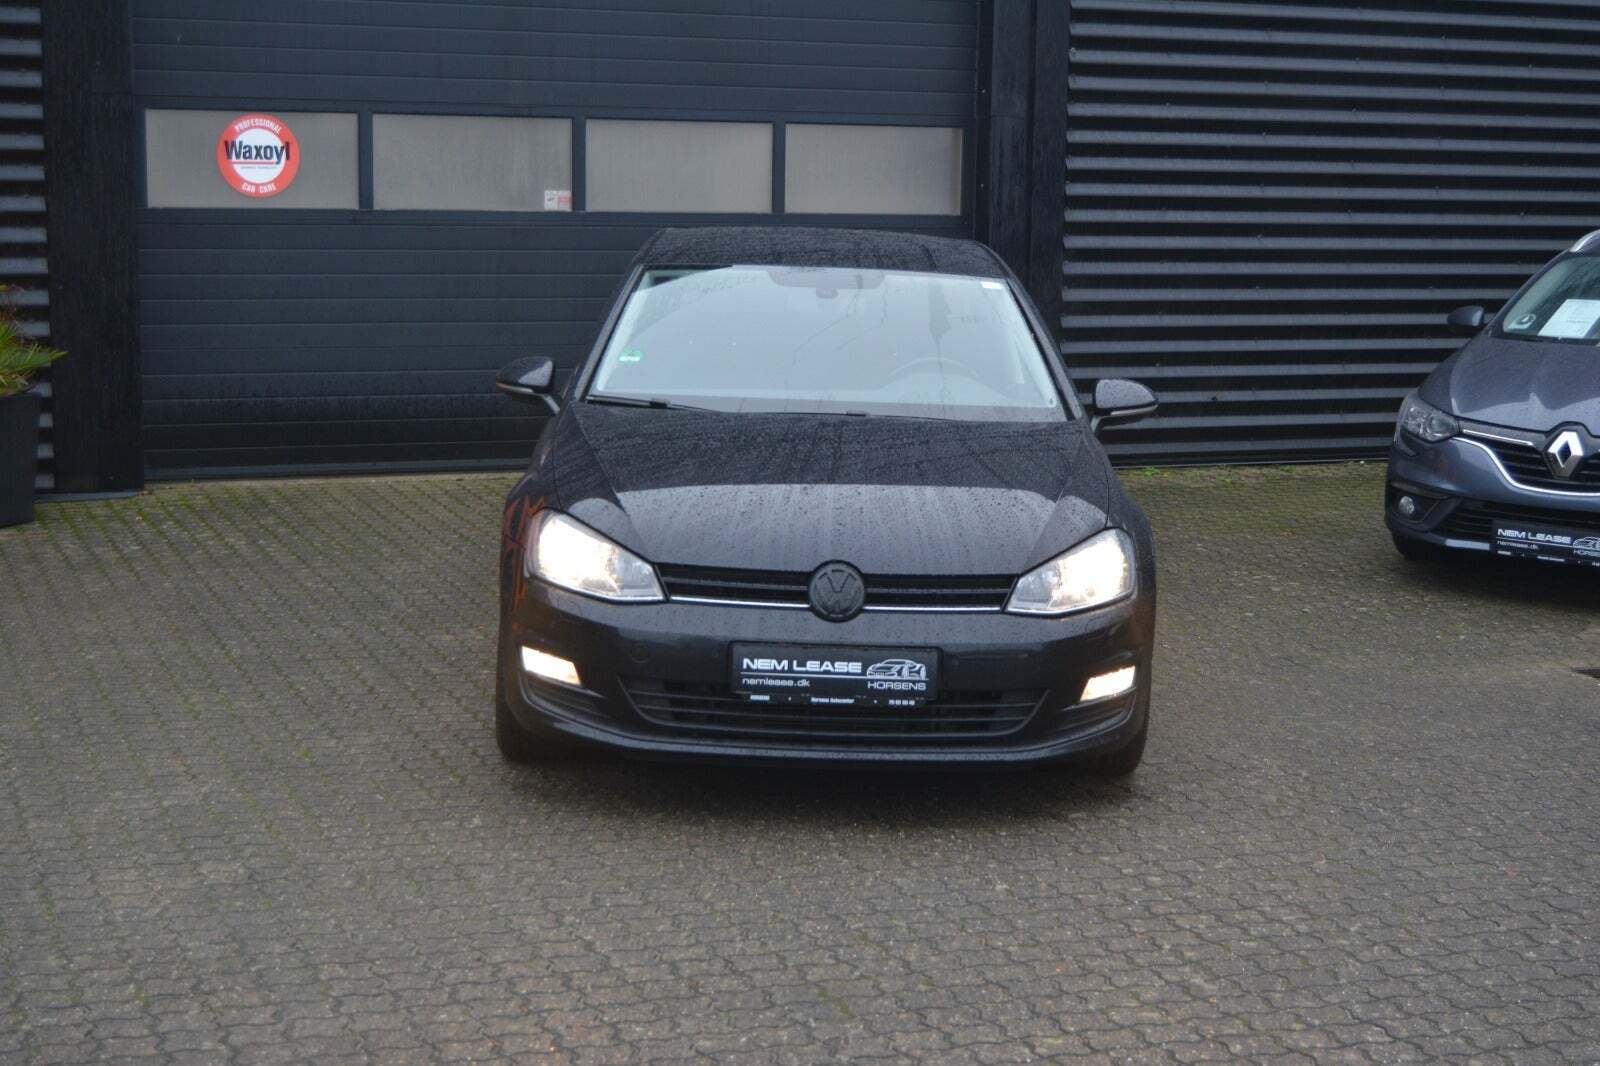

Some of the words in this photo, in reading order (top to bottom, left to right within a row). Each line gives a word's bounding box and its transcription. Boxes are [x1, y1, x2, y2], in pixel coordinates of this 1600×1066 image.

[224, 140, 290, 165] Waxoyl
[242, 183, 256, 192] CAR
[260, 183, 277, 193] CARE
[1497, 528, 1526, 538] NEM
[1527, 532, 1571, 544] LEASE
[743, 658, 788, 670] NEM
[793, 660, 862, 673] LEASE
[742, 678, 811, 687] nemlease.dk
[867, 681, 927, 691] HORSENS
